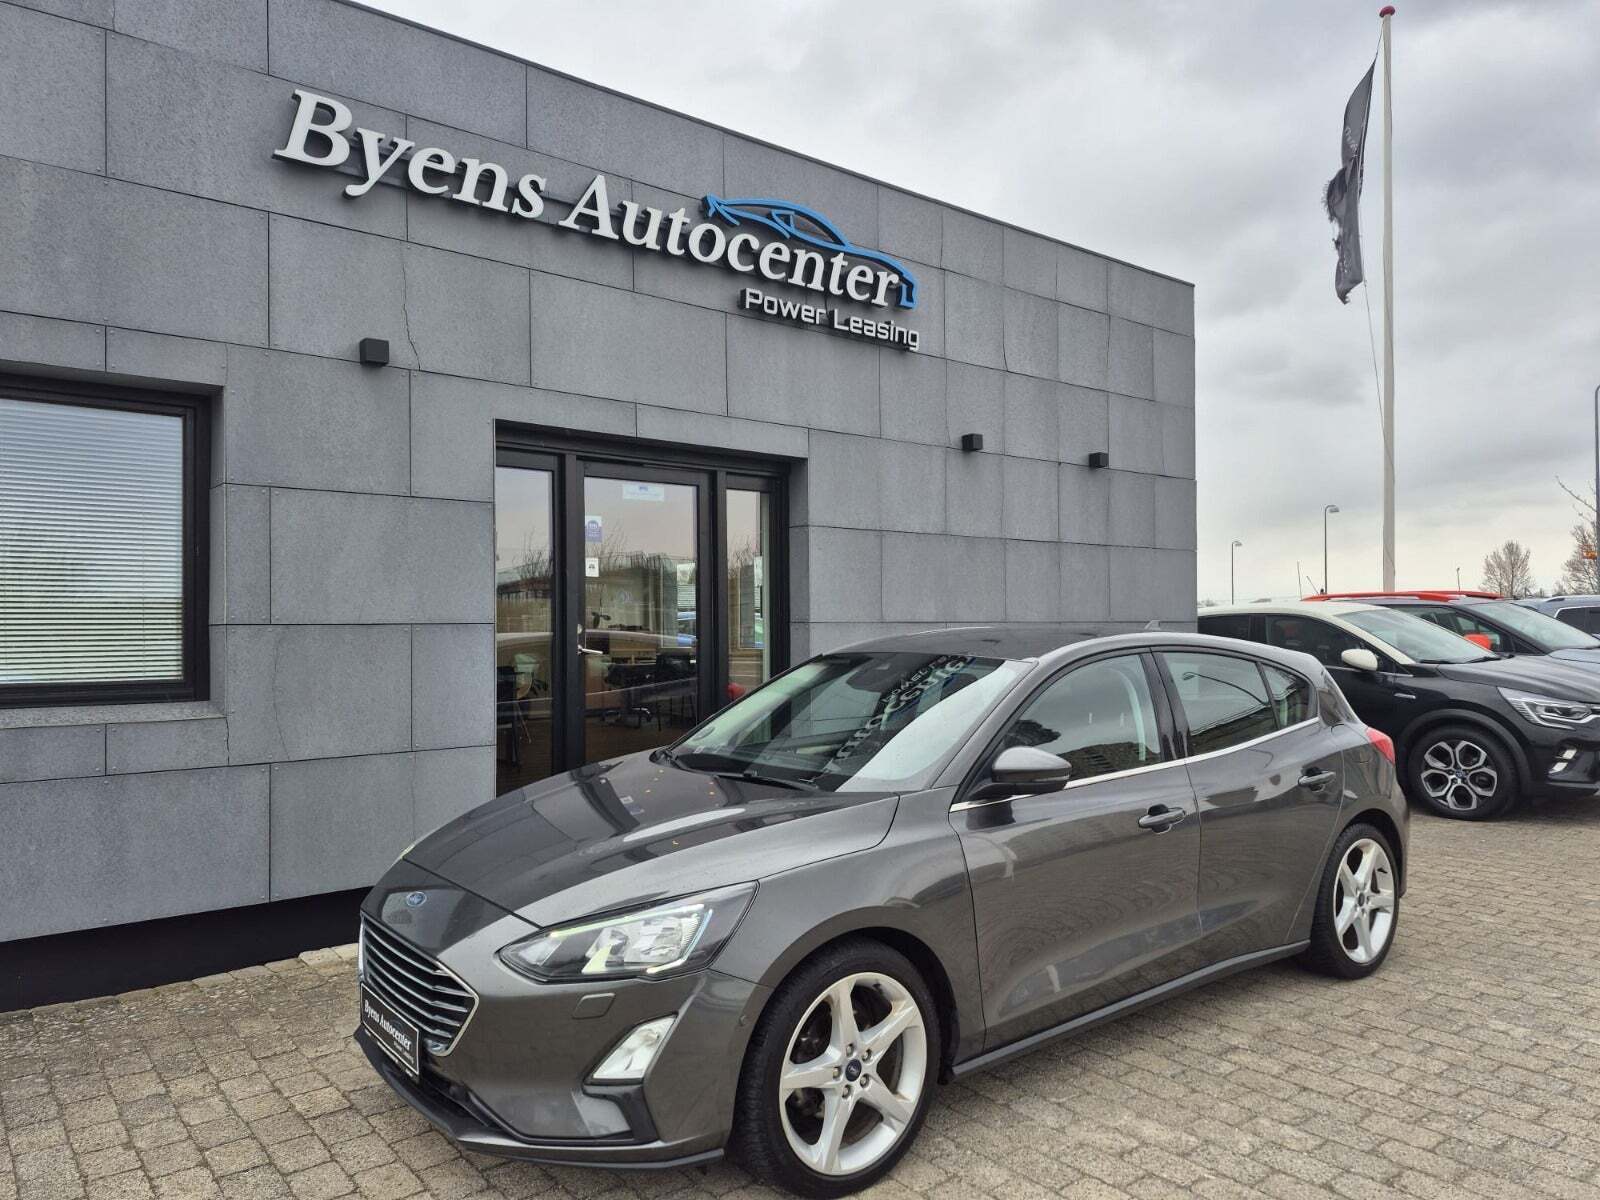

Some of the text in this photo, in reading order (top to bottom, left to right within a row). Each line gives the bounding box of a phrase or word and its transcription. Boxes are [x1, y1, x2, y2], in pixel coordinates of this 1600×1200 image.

[272, 88, 900, 308] Byens Autocenter
[745, 288, 921, 352] Power Leasing
